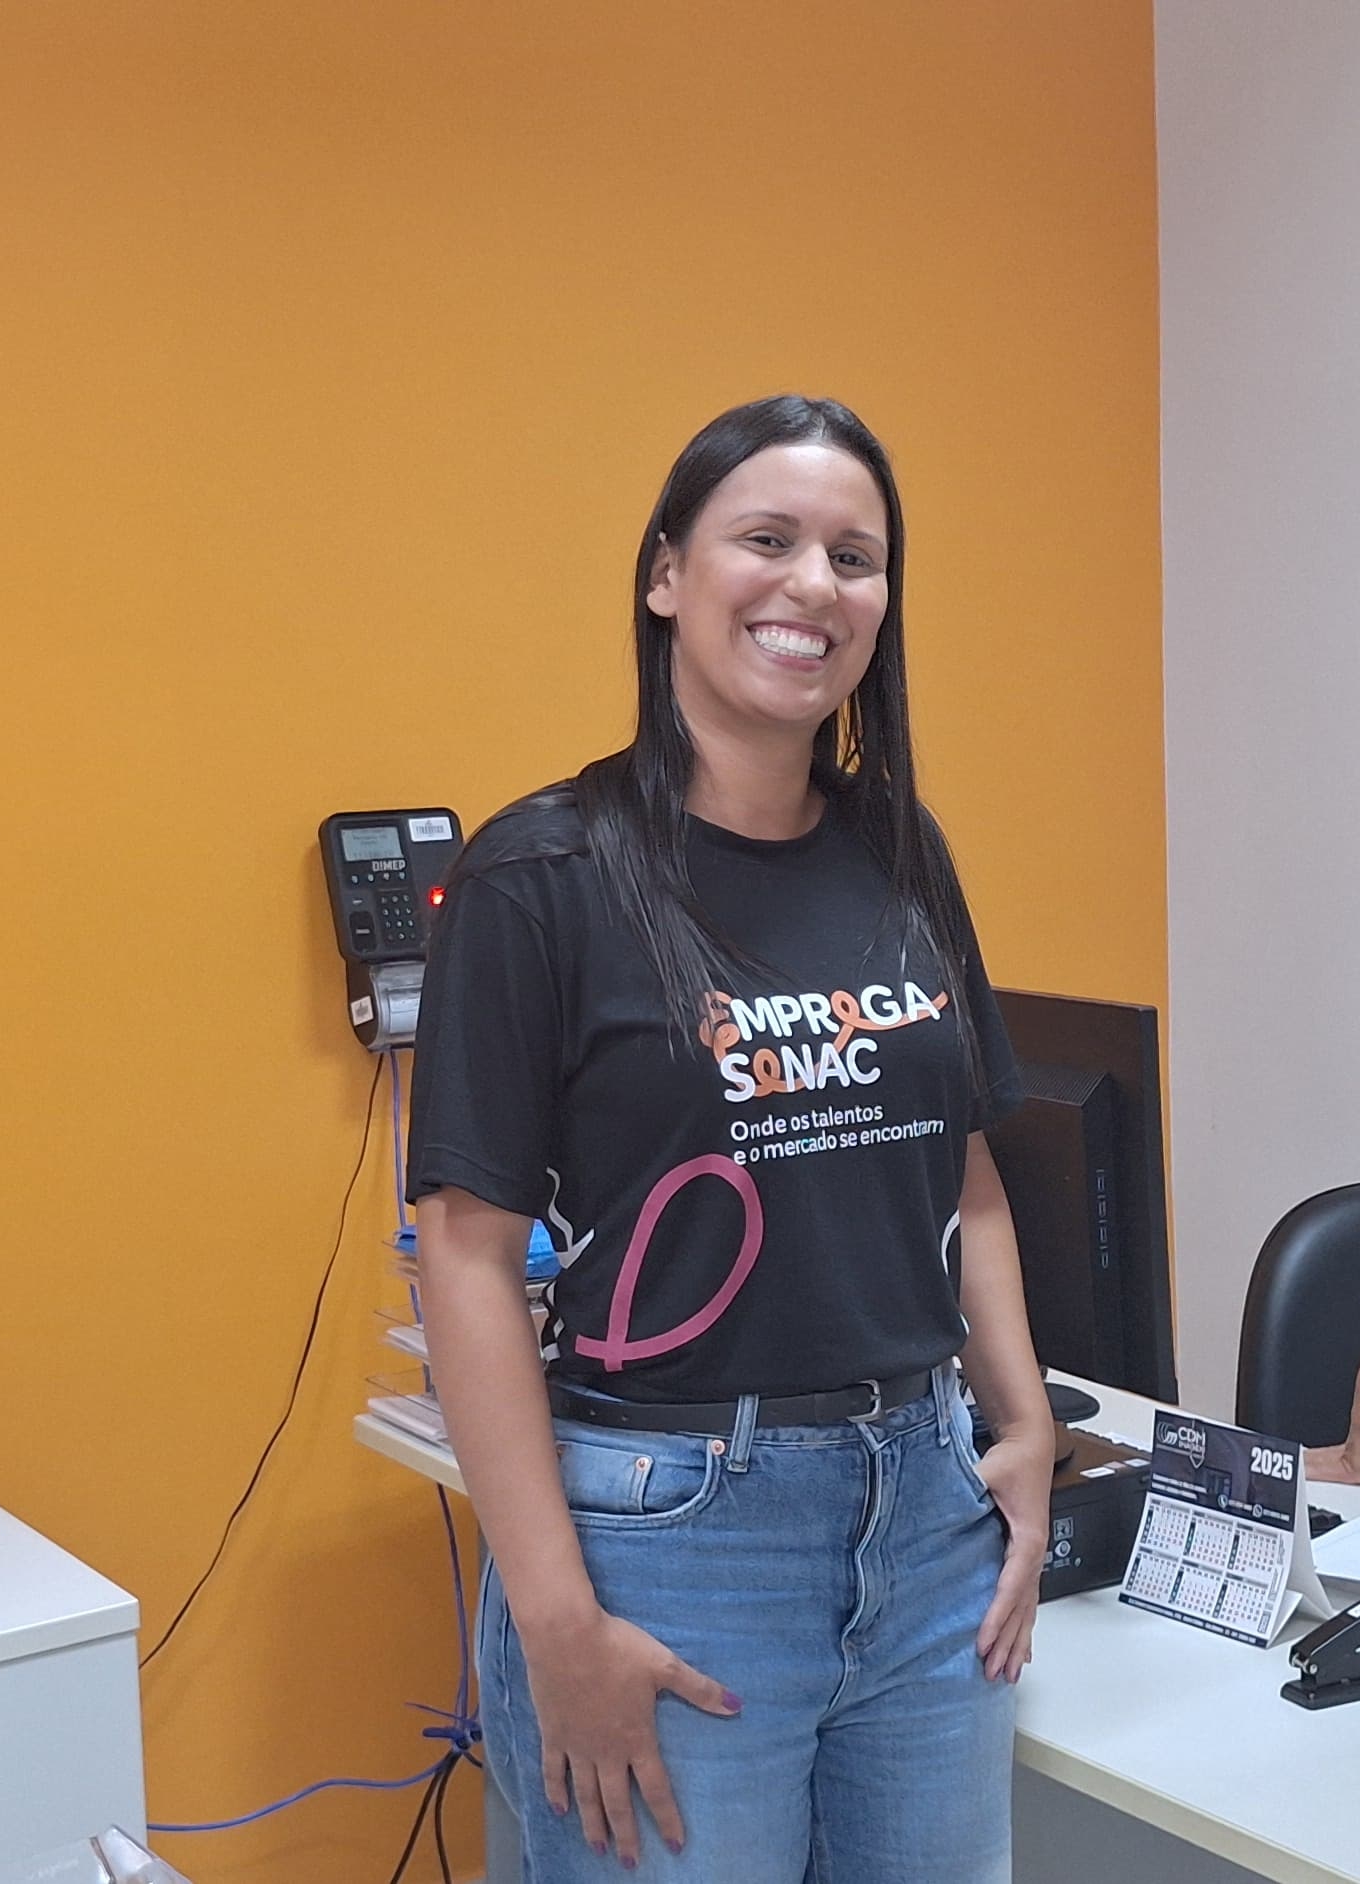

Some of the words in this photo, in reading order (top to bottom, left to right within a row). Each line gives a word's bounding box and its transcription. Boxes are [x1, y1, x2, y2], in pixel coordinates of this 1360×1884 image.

[372, 859, 406, 872] DIMEP
[730, 1114, 788, 1141] Onde
[790, 1114, 810, 1131] os
[811, 1104, 884, 1129] talentos
[733, 1150, 747, 1166] e
[749, 1147, 761, 1163] o
[763, 1129, 838, 1160] mercado
[839, 1132, 858, 1149] se
[860, 1119, 945, 1145] encontram
[1250, 1446, 1294, 1481] 2025
